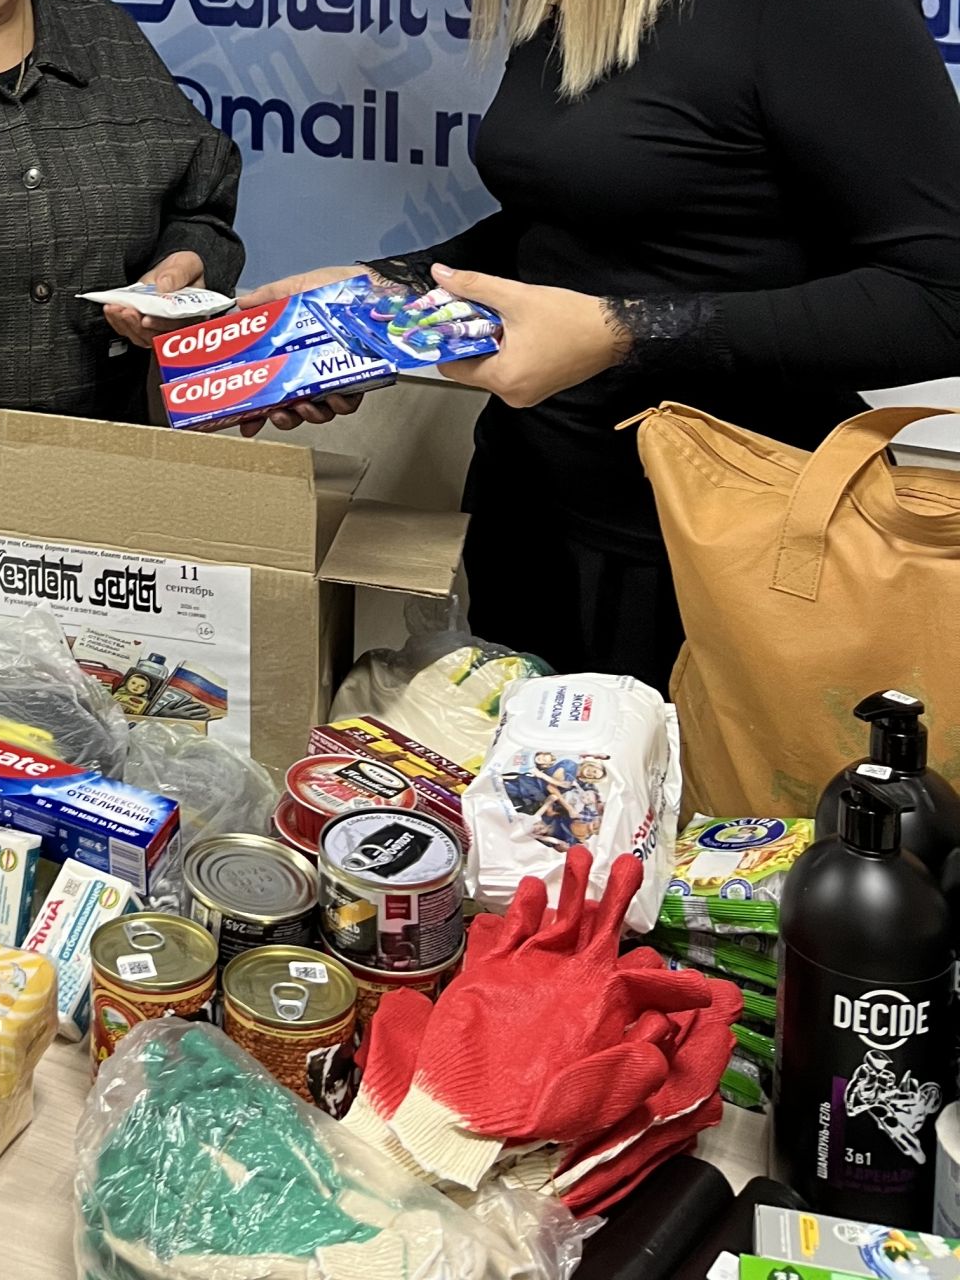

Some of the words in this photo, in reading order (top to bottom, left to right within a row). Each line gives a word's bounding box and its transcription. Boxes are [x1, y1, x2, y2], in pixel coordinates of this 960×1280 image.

[161, 312, 267, 358] Colgate
[312, 353, 382, 376] WHIT
[169, 366, 269, 404] Colgate
[165, 583, 215, 598] сентябрь
[180, 565, 199, 582] 11
[198, 627, 214, 636] 16+
[405, 740, 472, 779] BERNLE
[67, 789, 157, 826] ОТБЕЛИВАНИЕ
[78, 784, 157, 817] КОМПЛЕКСНОЕ
[107, 822, 117, 831] 14
[28, 898, 65, 954] RMA
[833, 994, 930, 1037] DECIDE
[817, 1101, 832, 1180] ШАМПУНЬ-ГЕЛЬ
